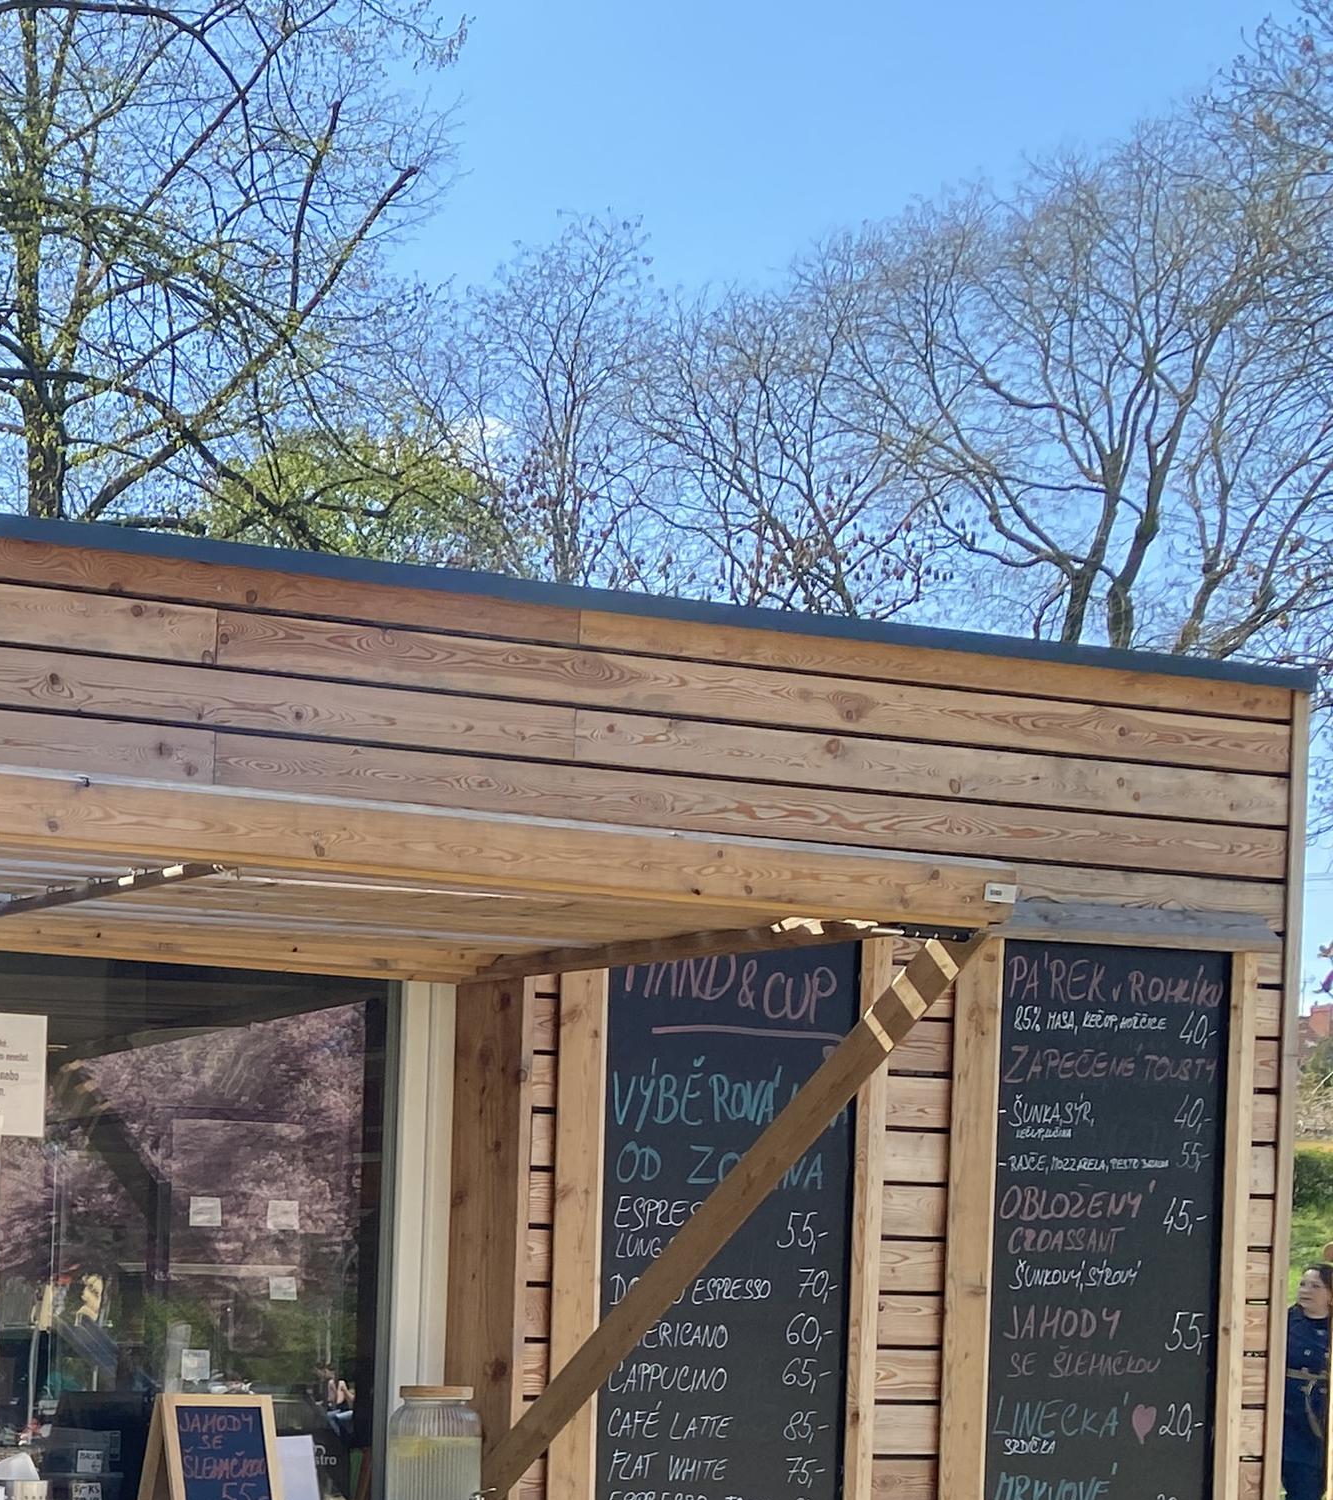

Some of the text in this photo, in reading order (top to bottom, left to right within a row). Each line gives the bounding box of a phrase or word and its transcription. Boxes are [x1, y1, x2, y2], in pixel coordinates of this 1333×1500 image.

[1008, 951, 1106, 1003] PÁREK
[1128, 965, 1224, 1008] ROHLÍKU
[1014, 1005, 1042, 1033] 85%
[0, 1070, 19, 1081] nebo
[1144, 1054, 1217, 1083] TOUSTY
[616, 1141, 661, 1183] OD
[614, 1195, 829, 1255] ESPRE 55,-
[1163, 1197, 1208, 1237] 45,-
[615, 1232, 676, 1259] LUNG
[691, 1277, 772, 1304] ESPRESSO
[637, 1319, 729, 1349] ERICANO
[1003, 1304, 1122, 1340] JAHODY
[607, 1361, 728, 1394] CAPPUCINO
[1007, 1352, 1037, 1378] SE
[179, 1412, 254, 1433] JAHODY
[607, 1401, 662, 1439] CAFÉ
[669, 1412, 734, 1440] LATTE
[992, 1392, 1130, 1438] LINECKÁ
[199, 1435, 223, 1450] SE
[314, 1453, 337, 1466] stro
[607, 1449, 660, 1483] FLAT
[668, 1454, 729, 1482] WHITE
